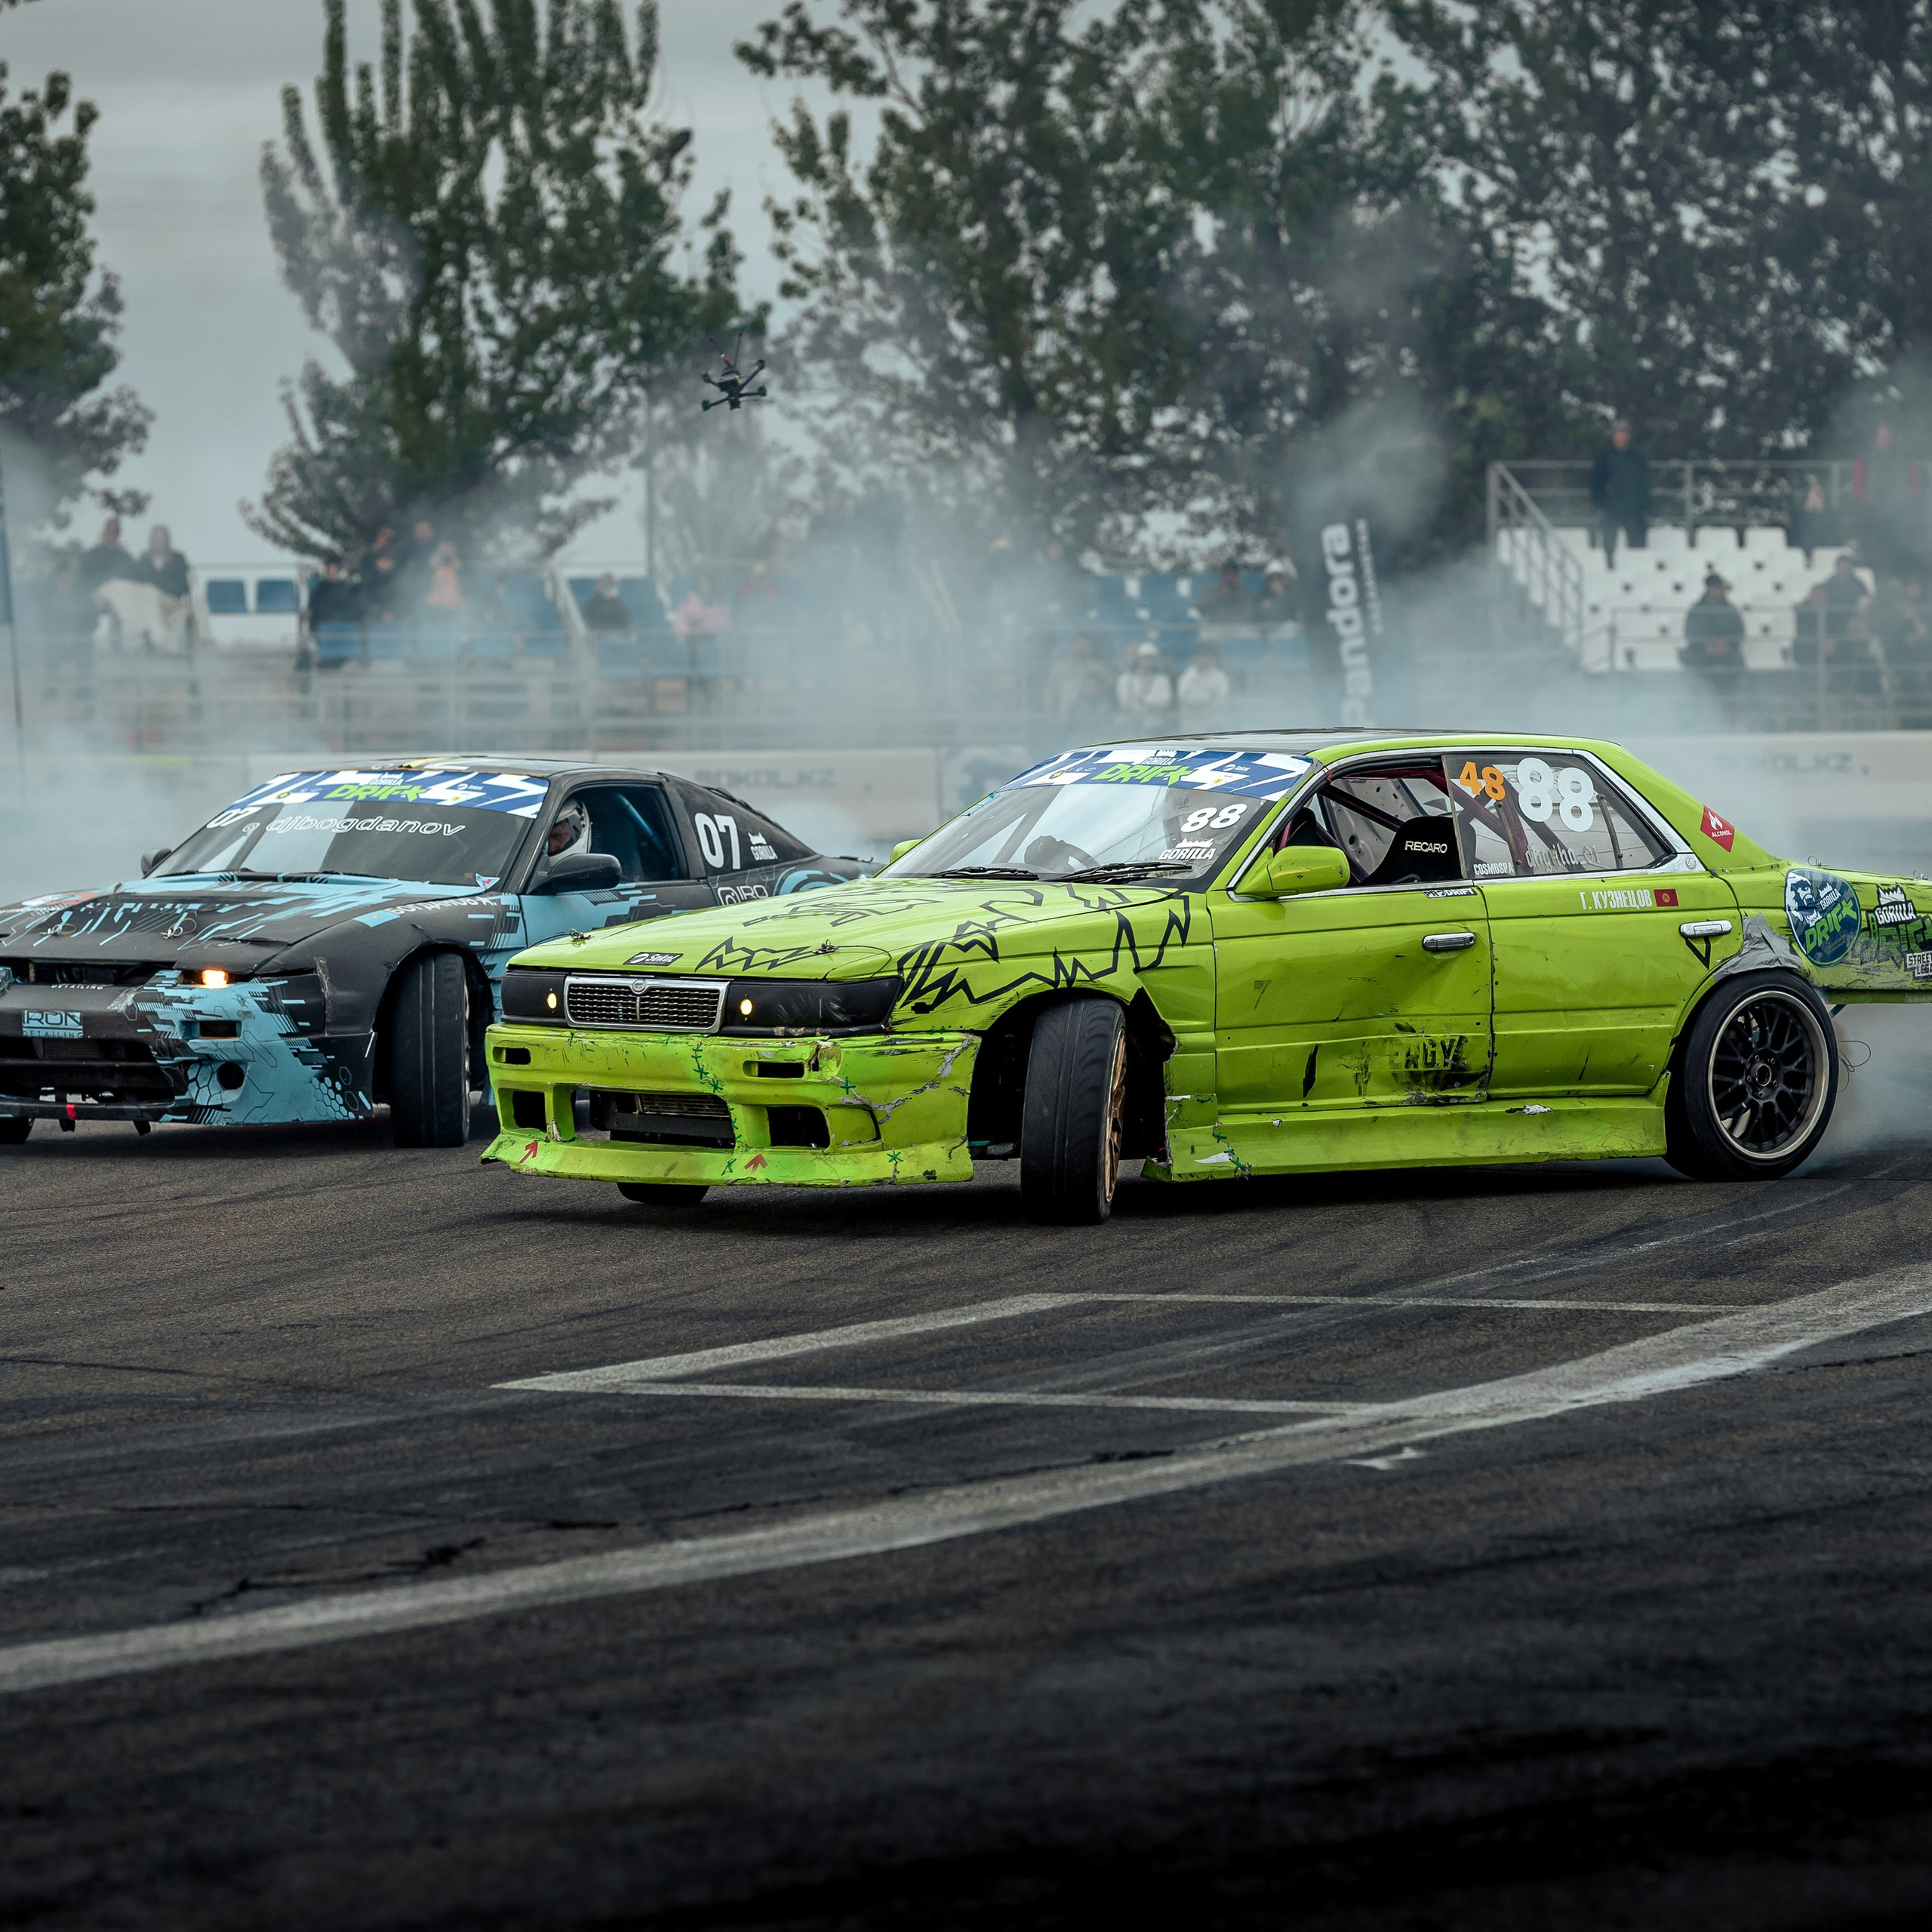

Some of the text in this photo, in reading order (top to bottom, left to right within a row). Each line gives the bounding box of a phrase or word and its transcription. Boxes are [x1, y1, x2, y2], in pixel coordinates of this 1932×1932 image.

[1459, 757, 1595, 832] 48 88
[205, 806, 263, 829] 07
[265, 815, 466, 836] djbogdanov
[1180, 803, 1248, 833] 88
[694, 812, 741, 870] 07
[1404, 840, 1447, 854] RECARO
[1158, 848, 1216, 860] GORILLA
[1592, 889, 1653, 909] КУЗНЕЦОВ
[1820, 888, 1841, 910] GORILLA
[1874, 902, 1917, 925] GORILLA
